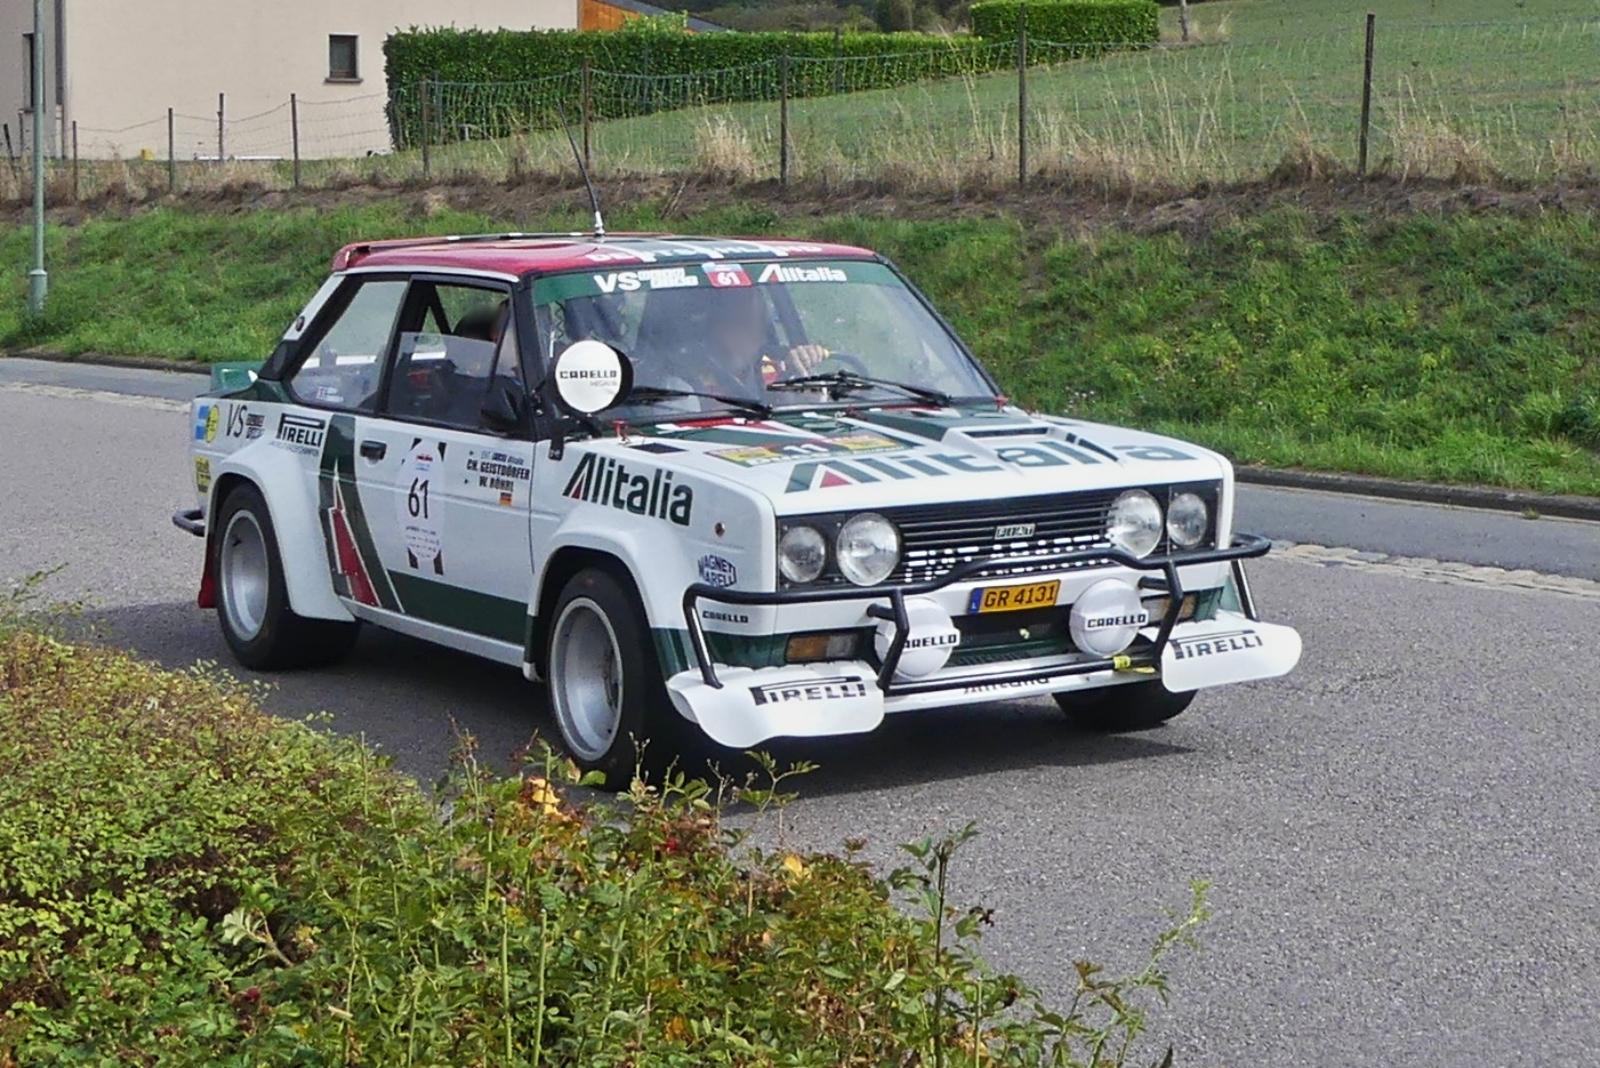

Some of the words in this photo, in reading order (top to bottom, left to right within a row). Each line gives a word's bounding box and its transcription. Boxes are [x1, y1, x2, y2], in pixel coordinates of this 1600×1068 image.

[594, 271, 641, 292] VS
[717, 272, 740, 286] 61
[757, 263, 847, 283] Alitalia
[559, 369, 617, 379] CARELLO
[226, 403, 248, 438] VS
[275, 412, 326, 447] PIRELLI
[784, 437, 1200, 494] Alitalia
[408, 477, 428, 519] 61
[562, 452, 693, 526] Alitalia
[984, 590, 1009, 608] GR
[1014, 584, 1056, 605] 4131
[1087, 613, 1147, 629] CARELLO
[903, 633, 957, 649] ARELLO
[1169, 629, 1263, 660] PIRELLI
[749, 675, 866, 706] PIRELLI
